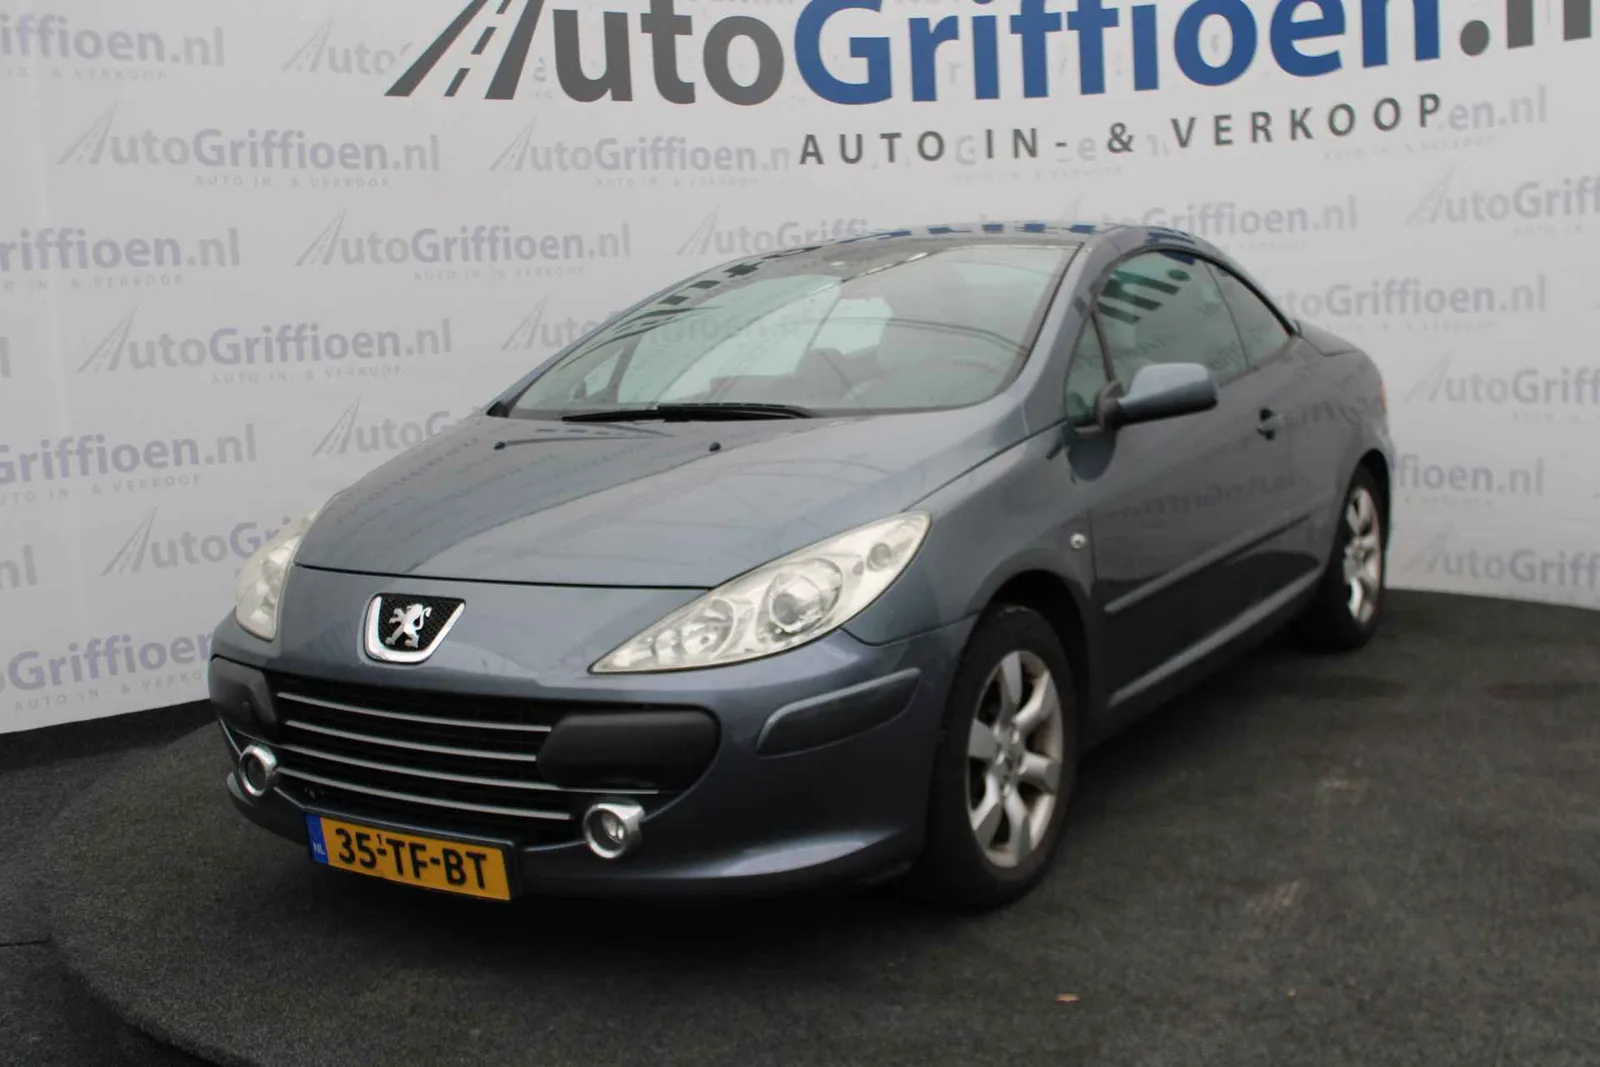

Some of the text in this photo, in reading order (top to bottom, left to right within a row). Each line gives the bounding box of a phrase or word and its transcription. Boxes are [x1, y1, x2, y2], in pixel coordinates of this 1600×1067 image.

[799, 129, 946, 166] AUTO
[1106, 122, 1135, 154] &
[1170, 92, 1442, 150] VERKOOP
[335, 827, 487, 890] 35-TF-BT
